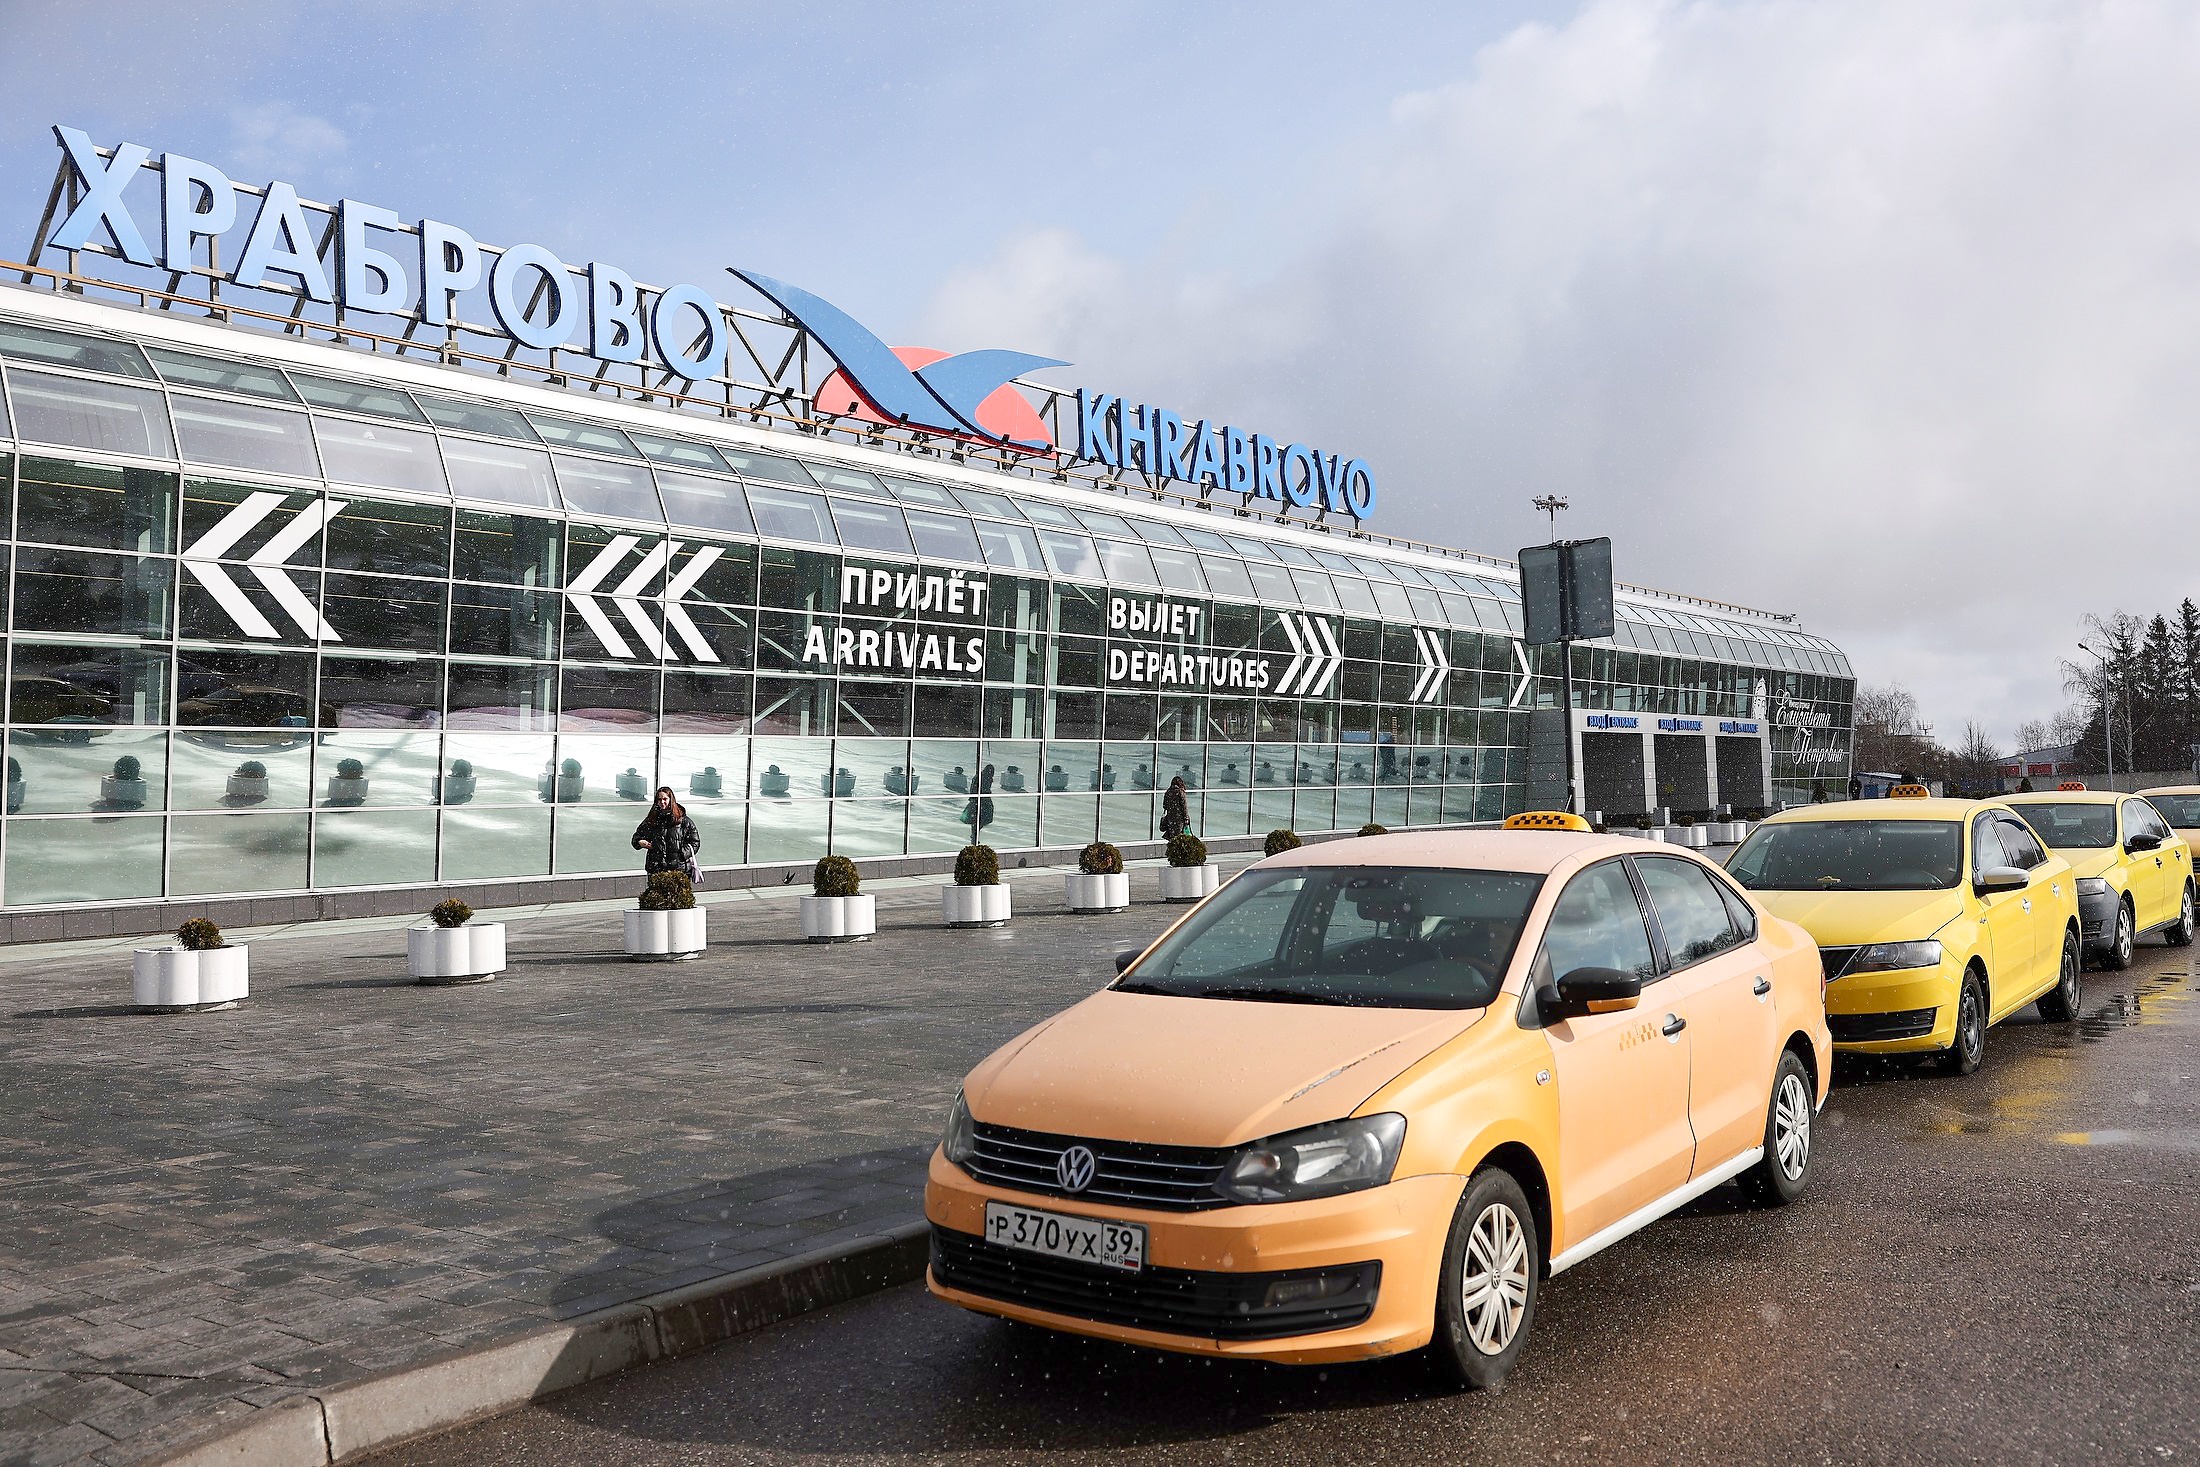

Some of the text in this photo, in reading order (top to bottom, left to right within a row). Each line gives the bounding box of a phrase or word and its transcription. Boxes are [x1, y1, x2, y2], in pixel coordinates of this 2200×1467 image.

[47, 124, 728, 382] ХРАБРОВО
[1077, 387, 1377, 520] KHRABROVO
[842, 566, 988, 617] ПРИЛЁТ
[1111, 597, 1201, 637] ВЫЛЕТ
[802, 625, 985, 673] ARRIVALS
[1109, 649, 1270, 690] DEPARTURES
[1587, 715, 1639, 729] ВХОД ENTRANCE
[1103, 1252, 1124, 1265] RUS
[1105, 1227, 1134, 1255] 39
